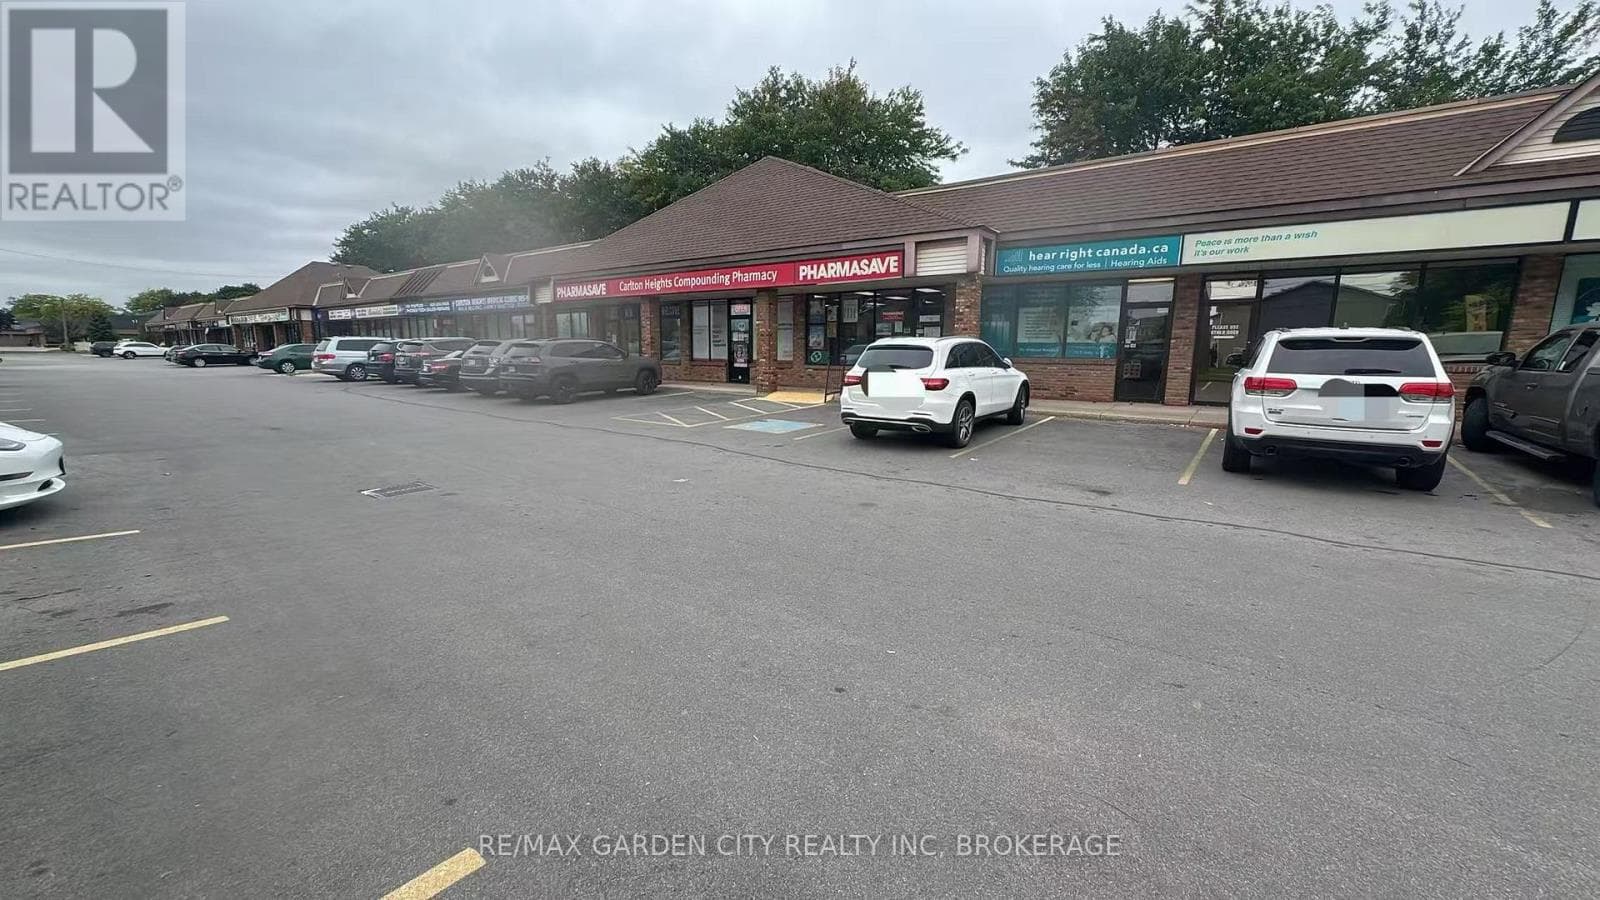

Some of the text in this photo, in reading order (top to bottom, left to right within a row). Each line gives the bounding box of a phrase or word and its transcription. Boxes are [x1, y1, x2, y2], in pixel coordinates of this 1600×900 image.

[1195, 239, 1222, 248] Peace
[1261, 233, 1283, 242] than
[1293, 230, 1318, 239] wish
[1028, 243, 1169, 262] hear right canada.ca
[1208, 248, 1225, 256] our
[1226, 246, 1250, 255] work
[799, 255, 899, 281] PHARMASAVE
[1003, 256, 1168, 274] Quality hearing care for less Hearing Aids
[619, 269, 778, 292] Carlton Heights Compounding Pharmacy
[556, 283, 607, 299] PHARMASAVE
